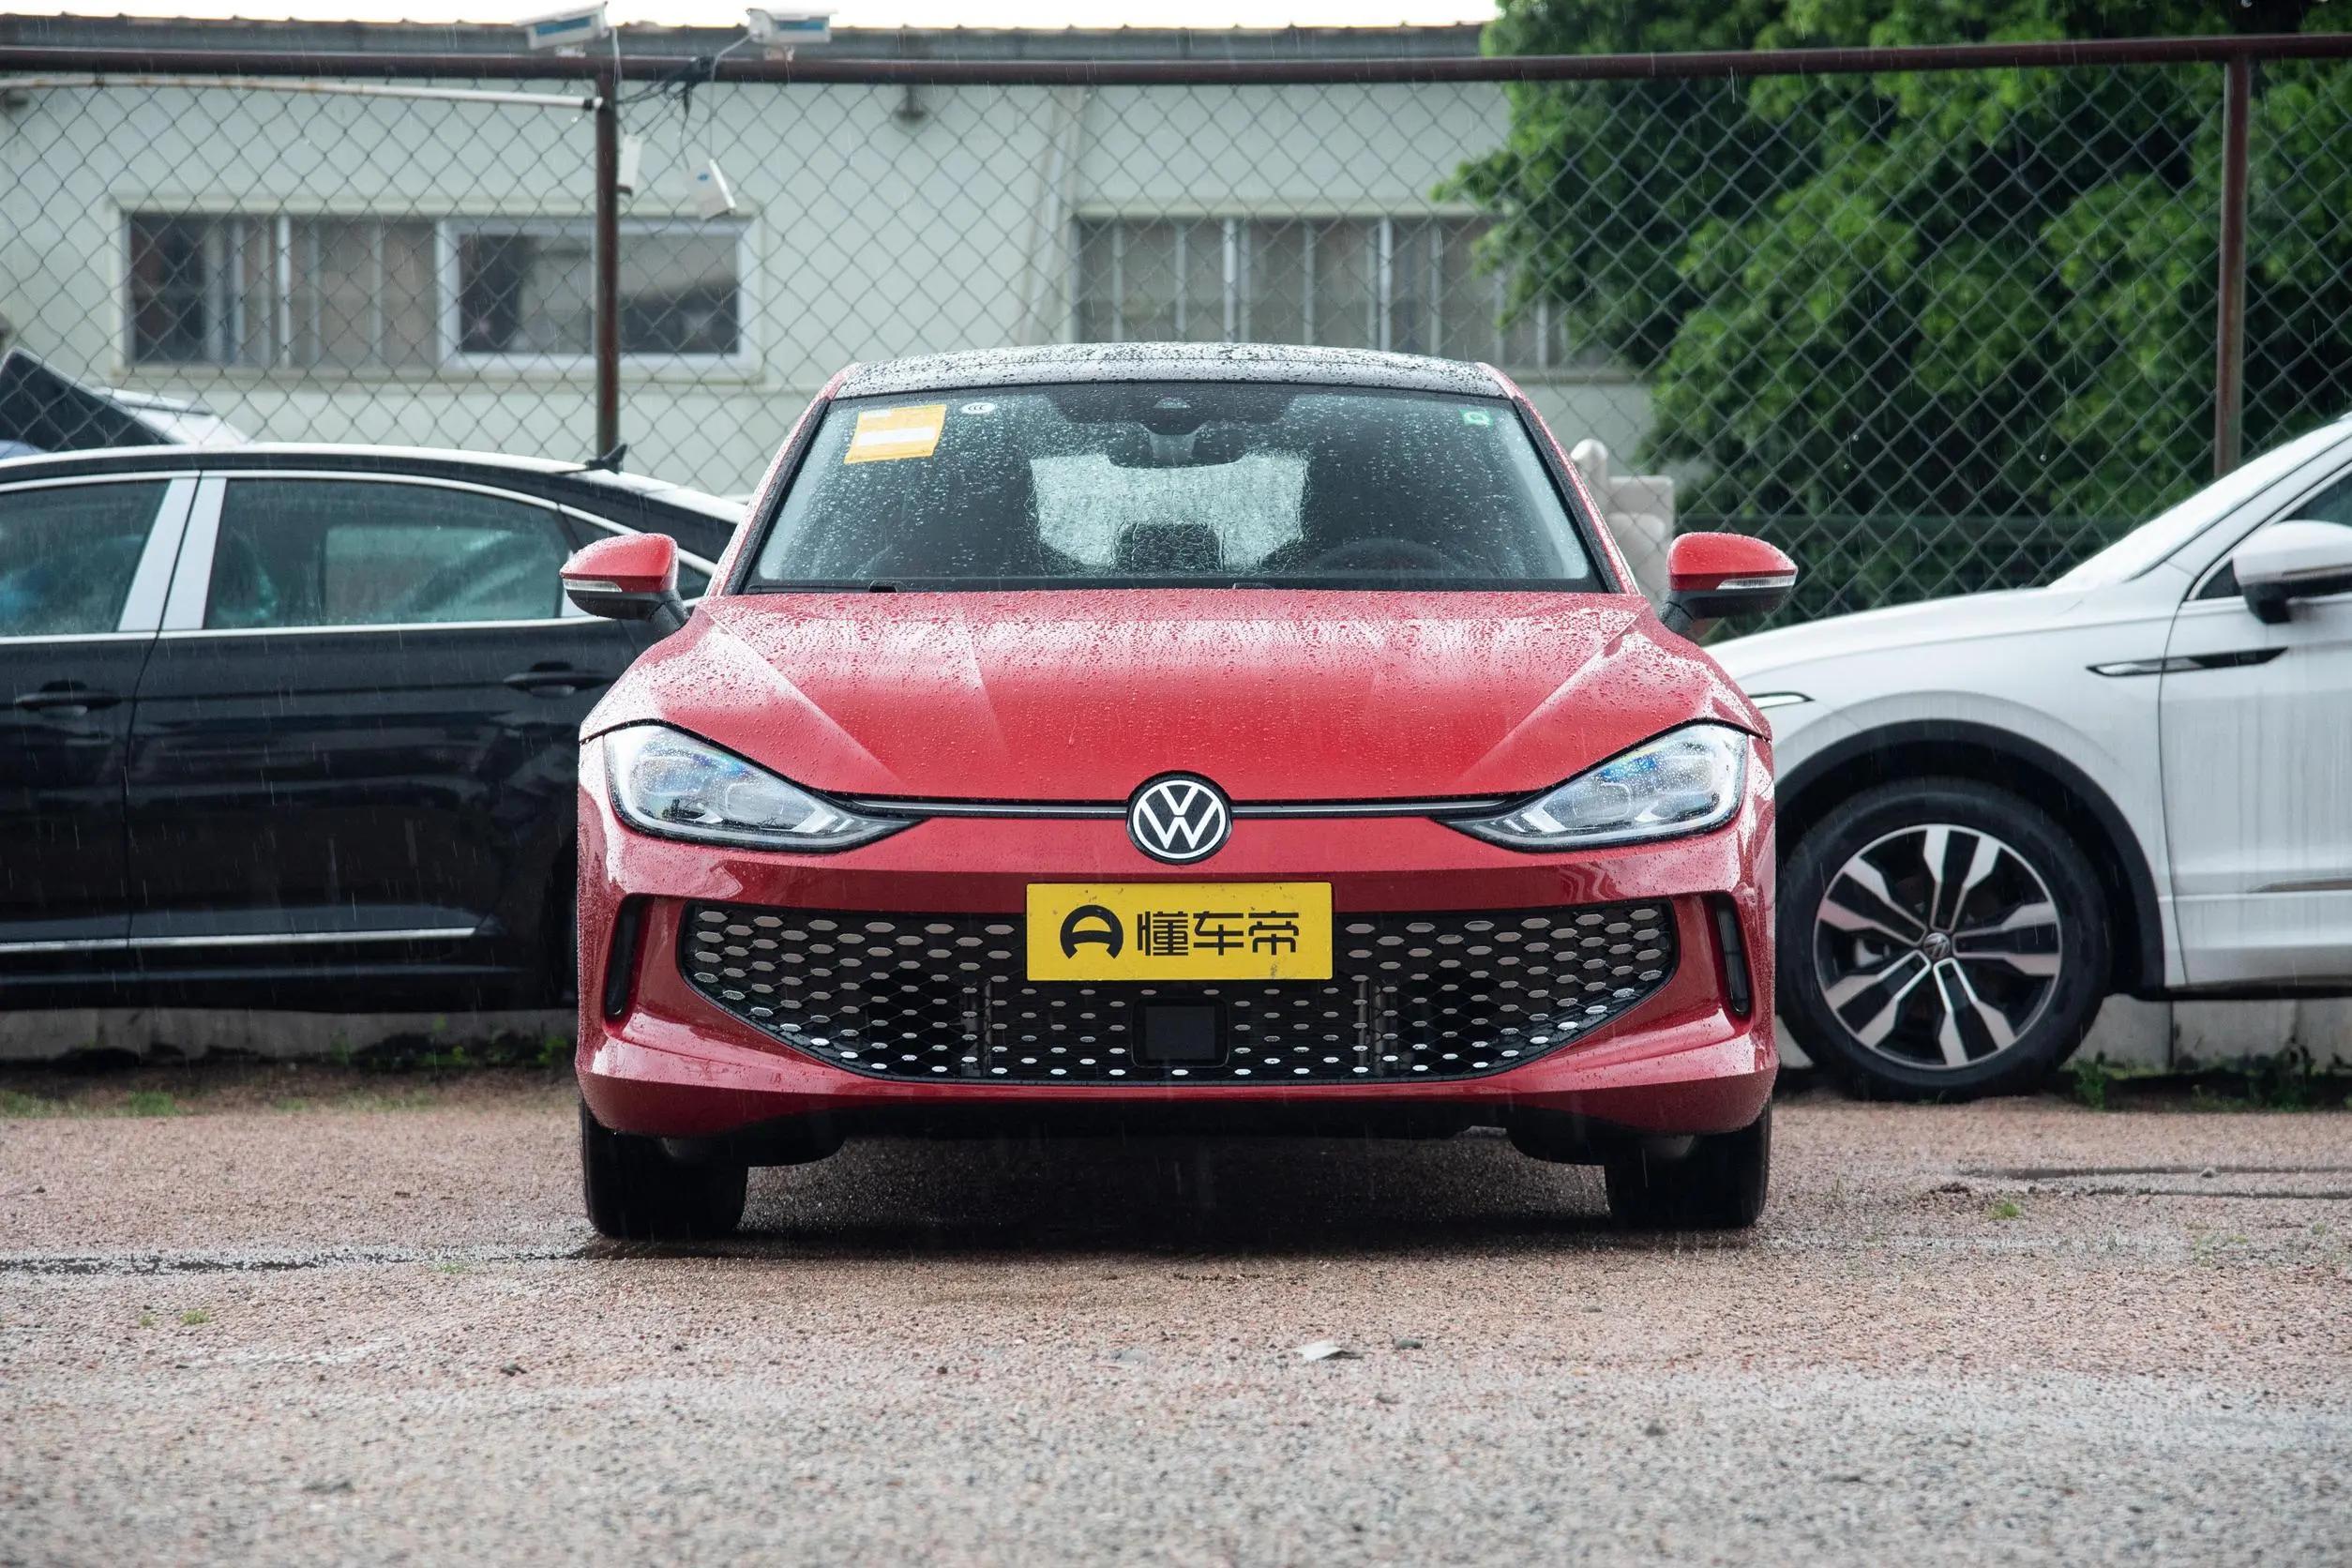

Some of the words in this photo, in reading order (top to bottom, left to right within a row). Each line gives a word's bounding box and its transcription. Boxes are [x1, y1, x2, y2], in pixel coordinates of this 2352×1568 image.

[1136, 781, 1223, 855] VW
[1137, 911, 1300, 957] 懂车帝
